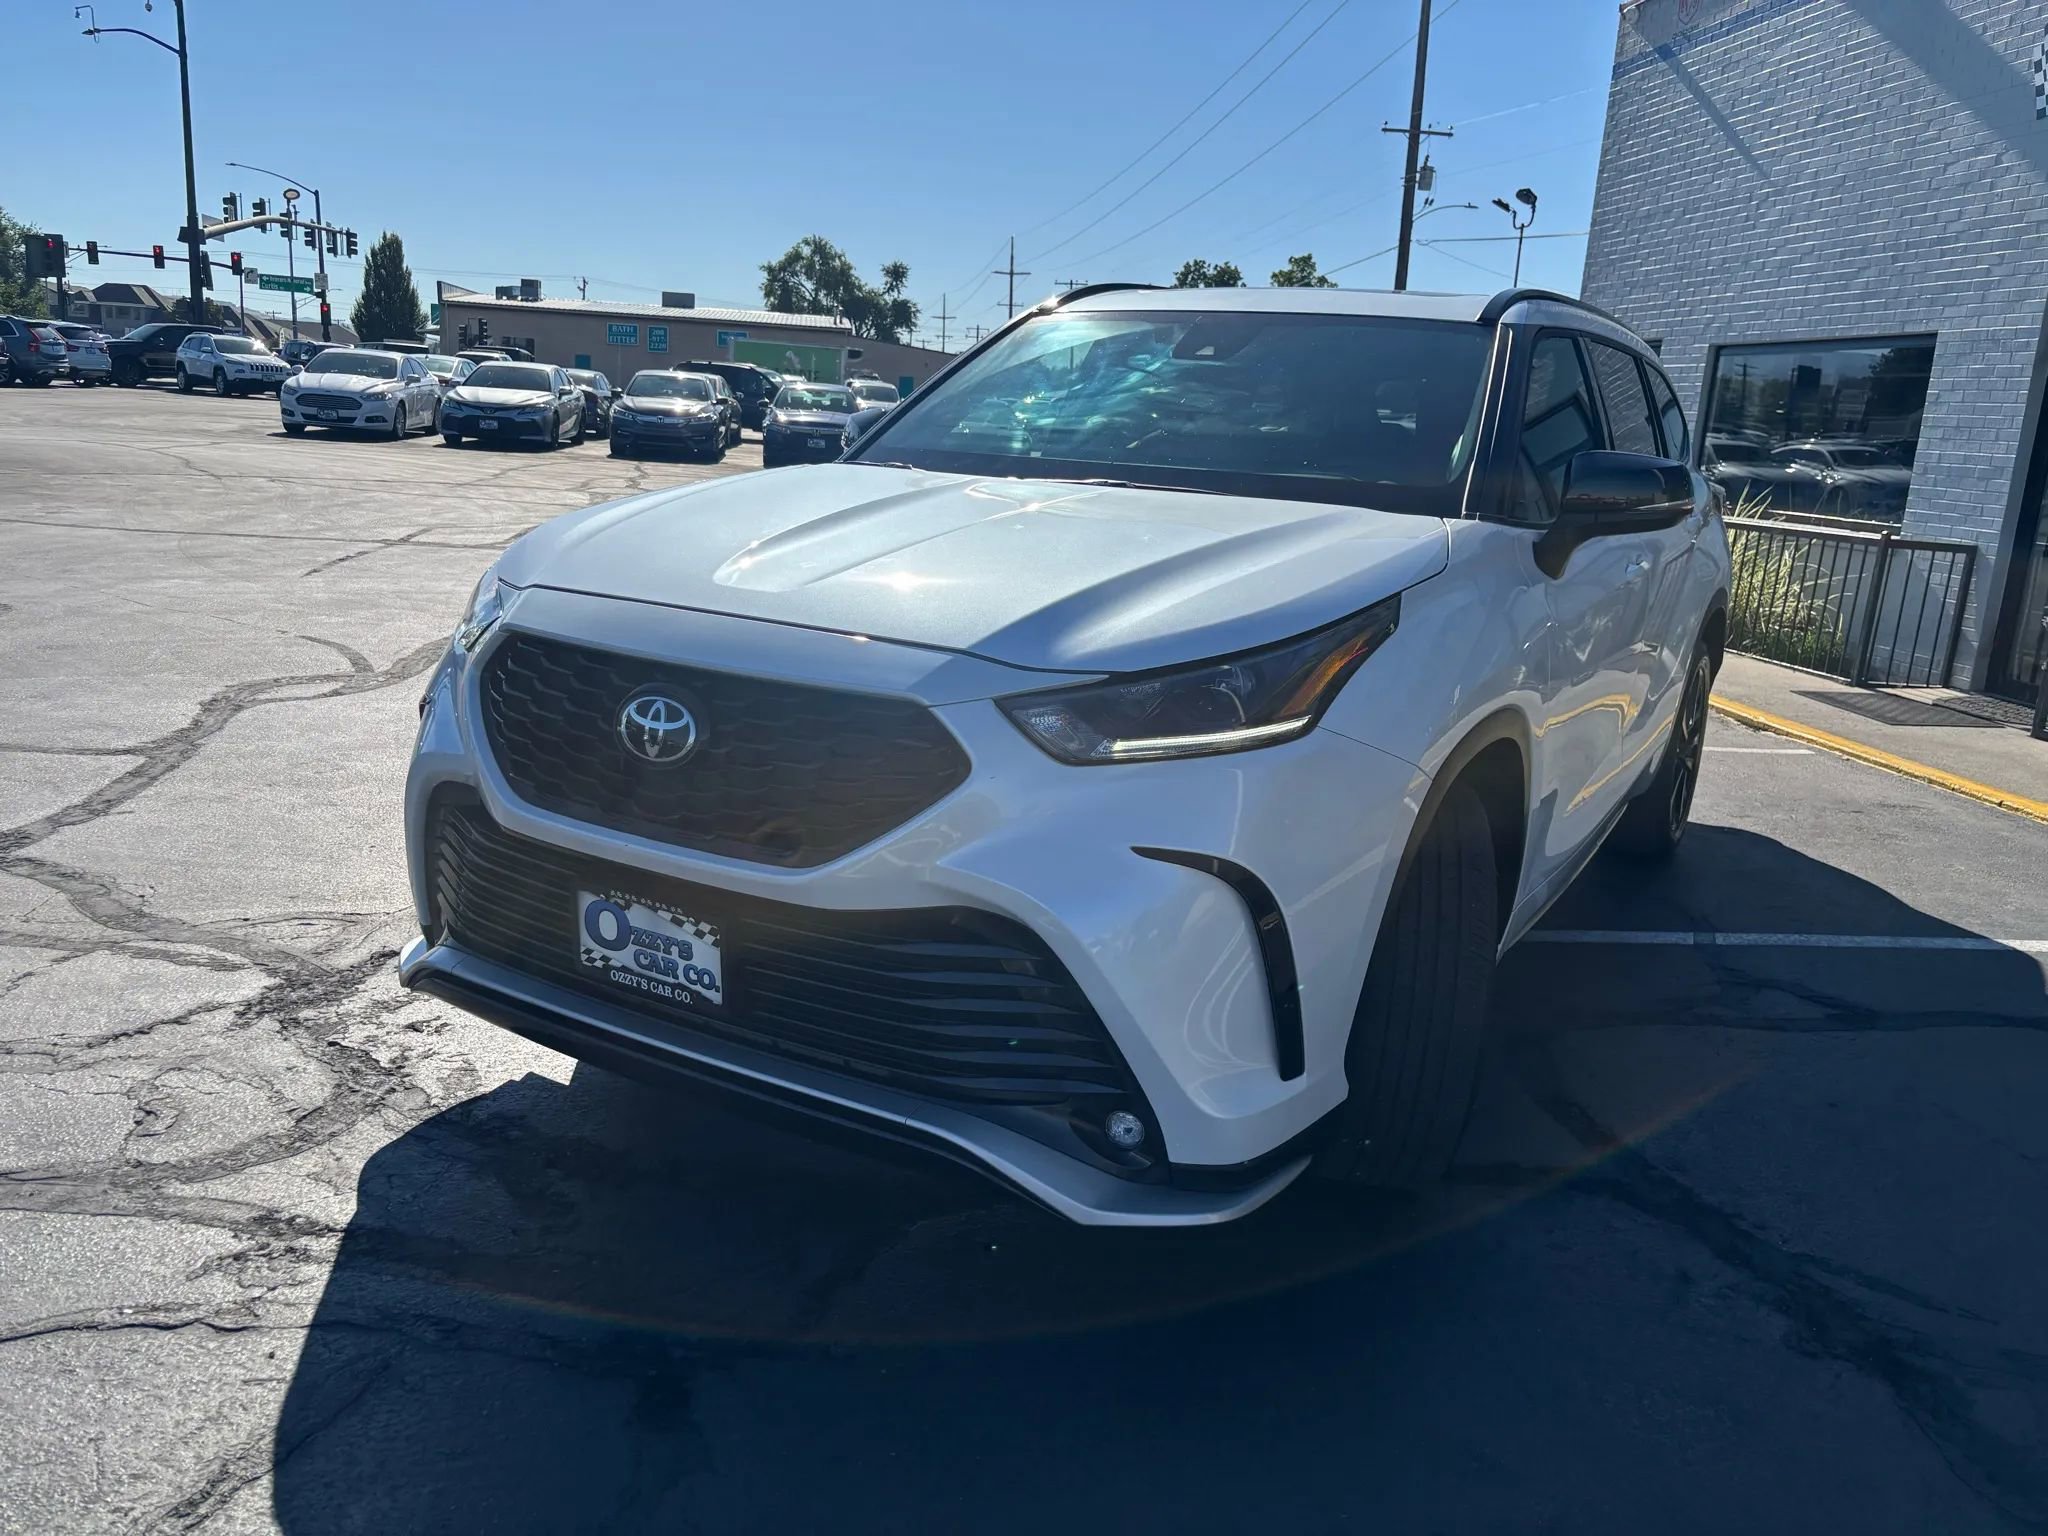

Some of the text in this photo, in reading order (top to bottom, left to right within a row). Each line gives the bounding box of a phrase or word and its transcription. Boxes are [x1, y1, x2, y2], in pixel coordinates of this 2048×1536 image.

[610, 970, 693, 1004] OZZY'S CAR CO.
[634, 949, 721, 993] CAR CO.
